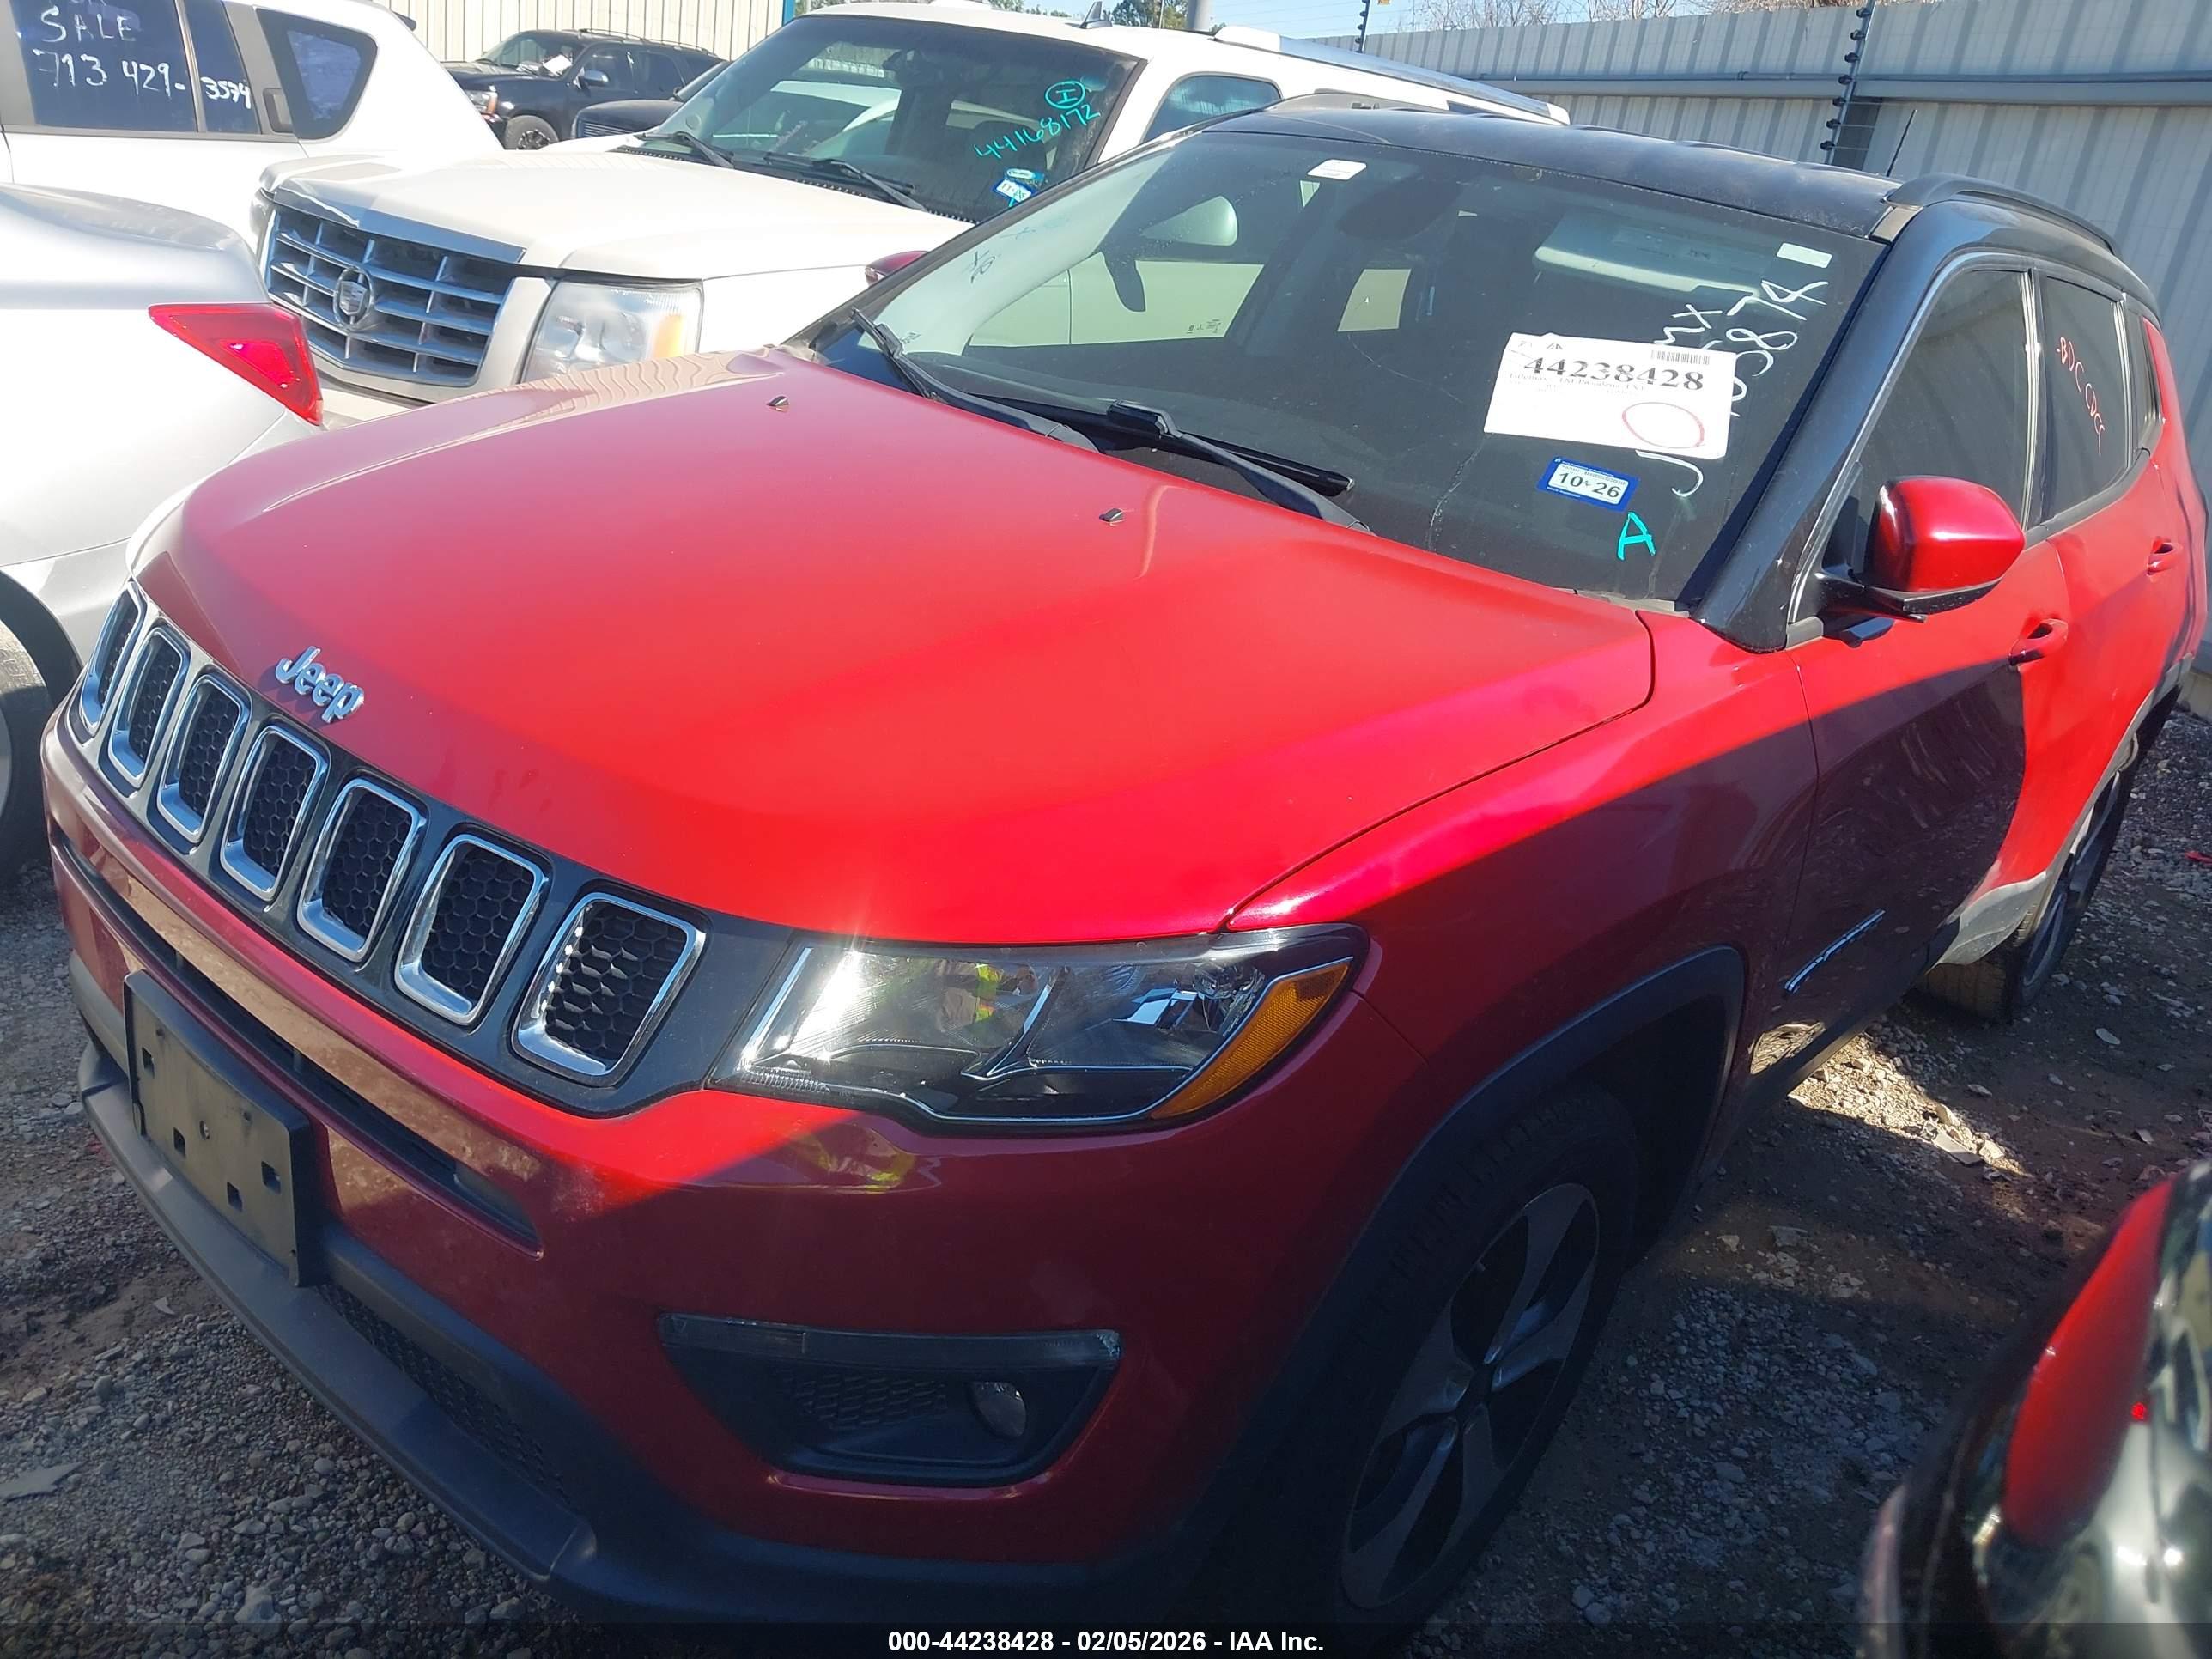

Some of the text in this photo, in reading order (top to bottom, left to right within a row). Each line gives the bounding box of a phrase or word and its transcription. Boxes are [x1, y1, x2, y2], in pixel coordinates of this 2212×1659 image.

[40, 6, 136, 42] SALE
[33, 48, 107, 87] 713
[973, 104, 1102, 160] 44168172
[1523, 356, 1704, 390] 44238428
[1559, 472, 1583, 488] 10
[1591, 482, 1621, 498] 26
[1618, 512, 1656, 560] A
[275, 646, 364, 723] Jeep
